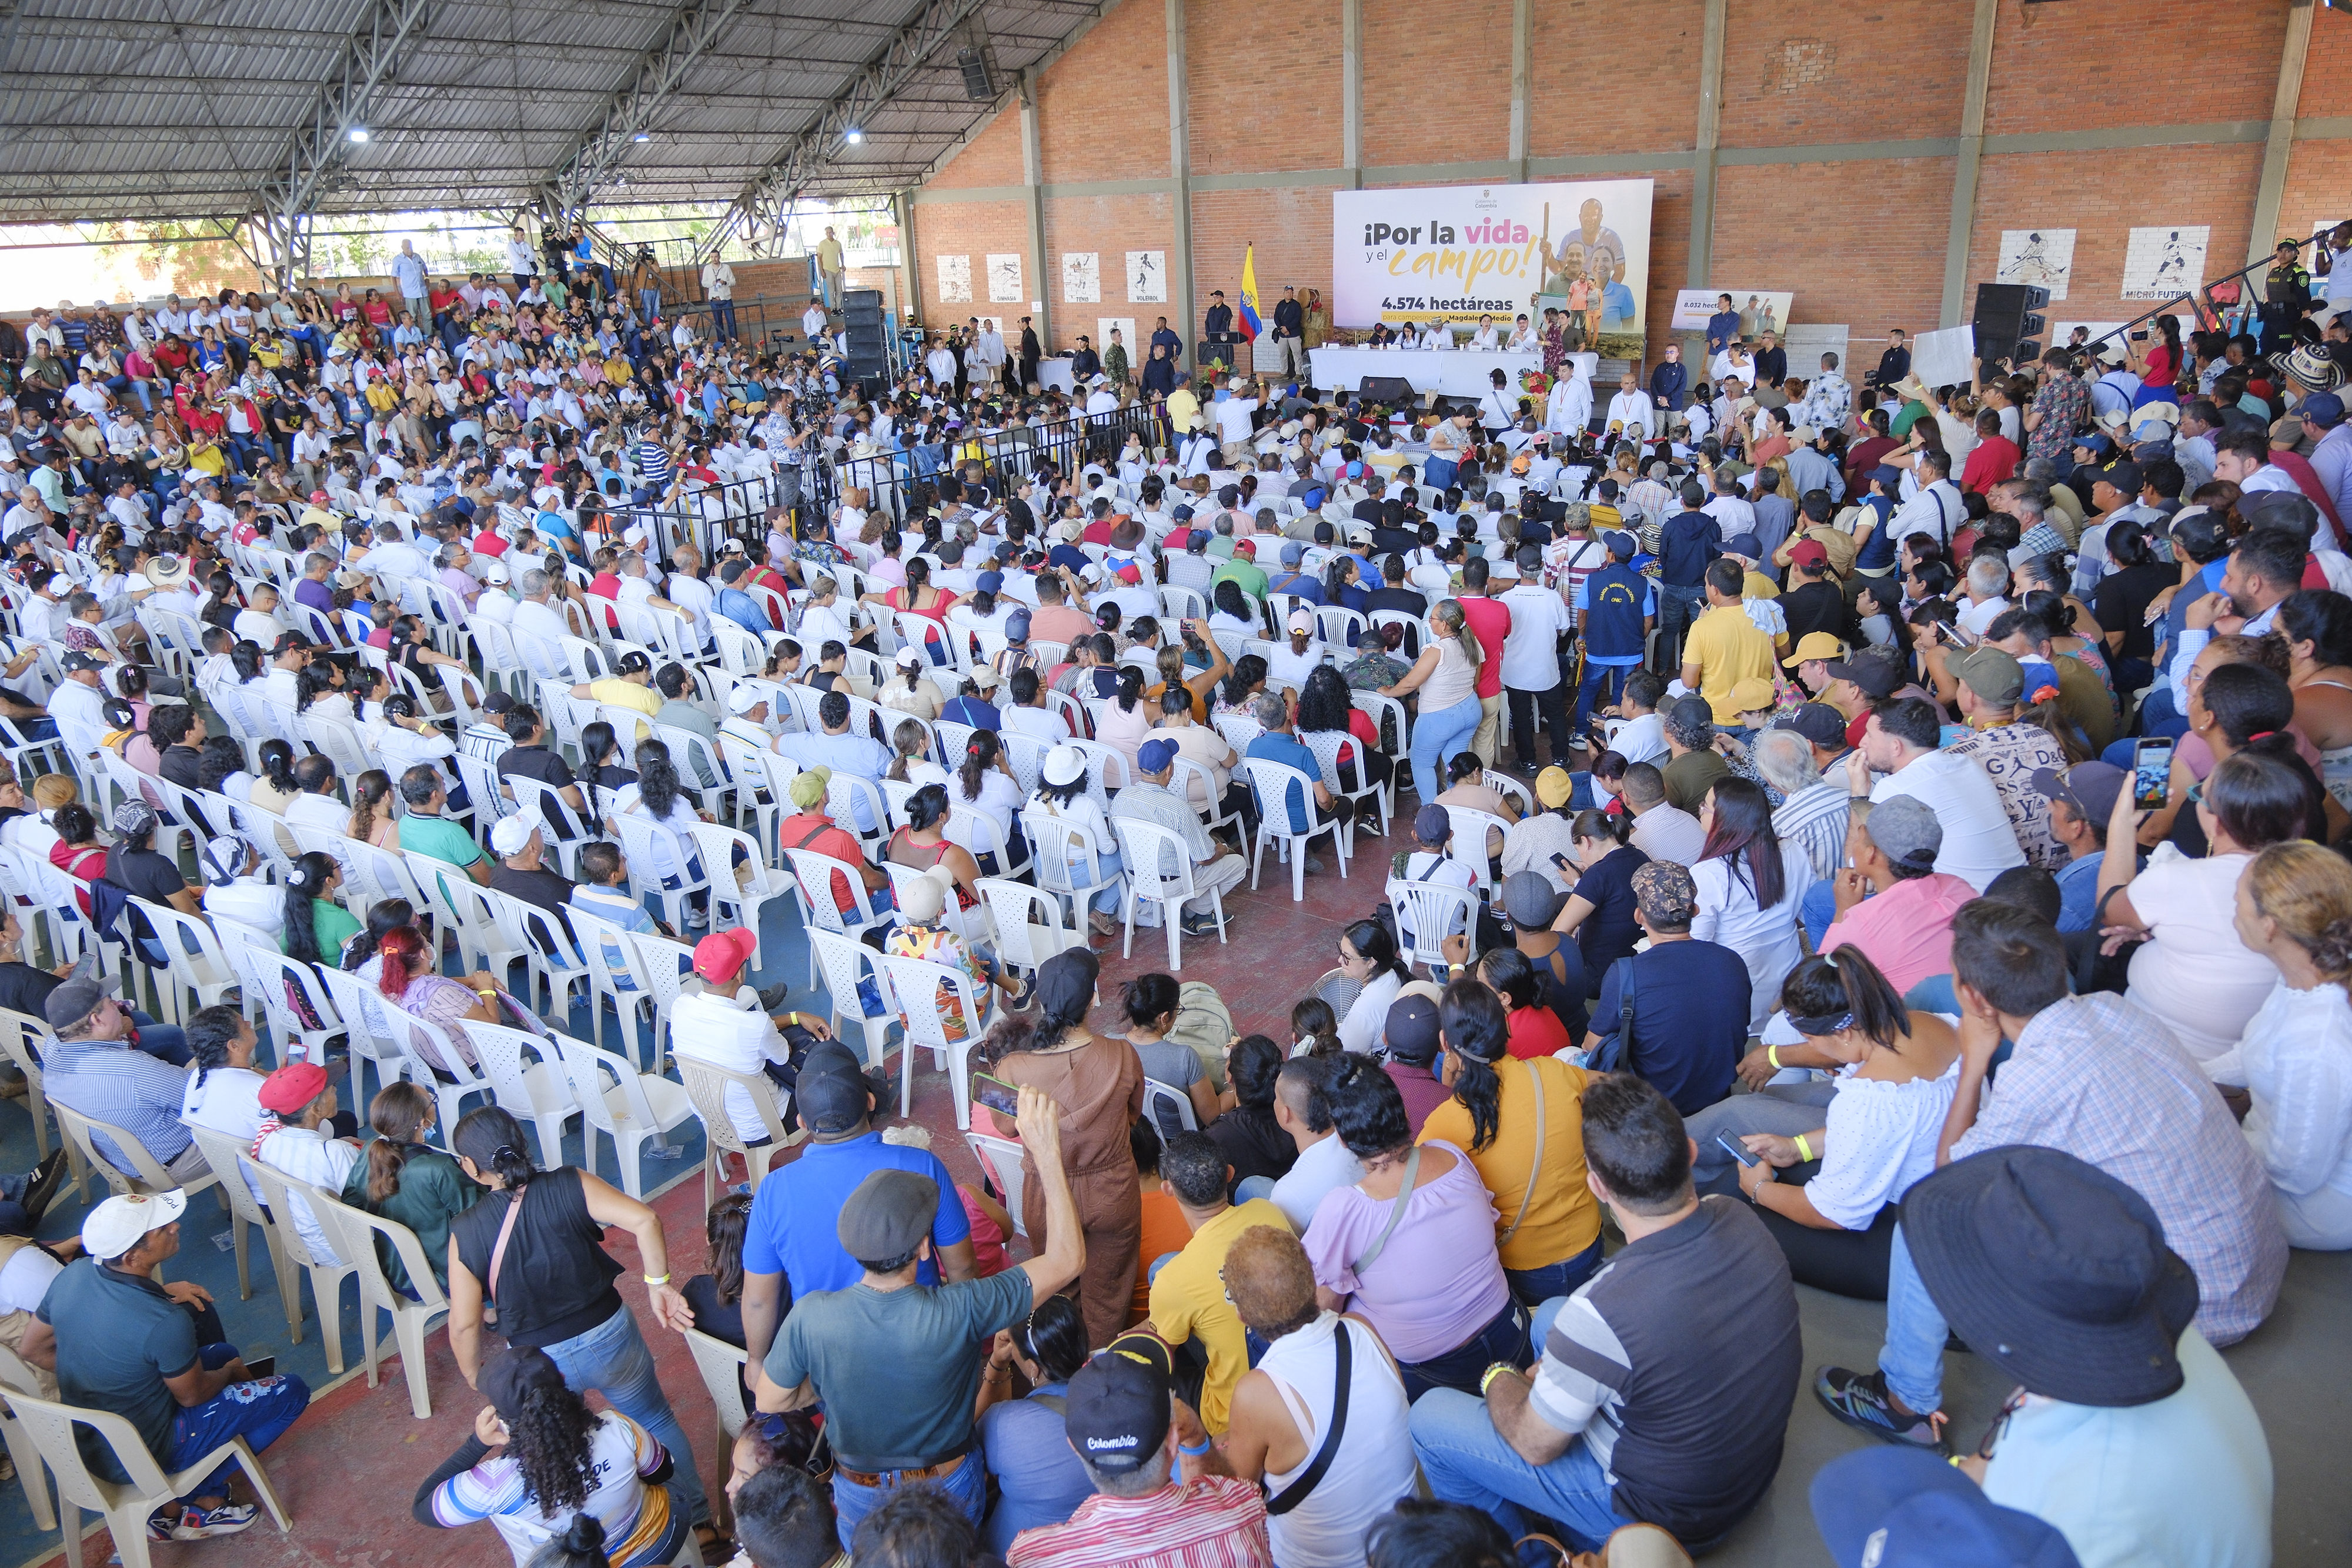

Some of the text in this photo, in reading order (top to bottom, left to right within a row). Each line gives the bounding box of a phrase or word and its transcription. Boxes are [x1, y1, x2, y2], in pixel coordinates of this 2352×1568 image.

[1365, 217, 1529, 246] ¡Por la vida
[1366, 235, 1538, 294] y el campo!
[1382, 296, 1514, 310] 4.574 hectáreas
[1087, 1434, 1138, 1450] Colombia
